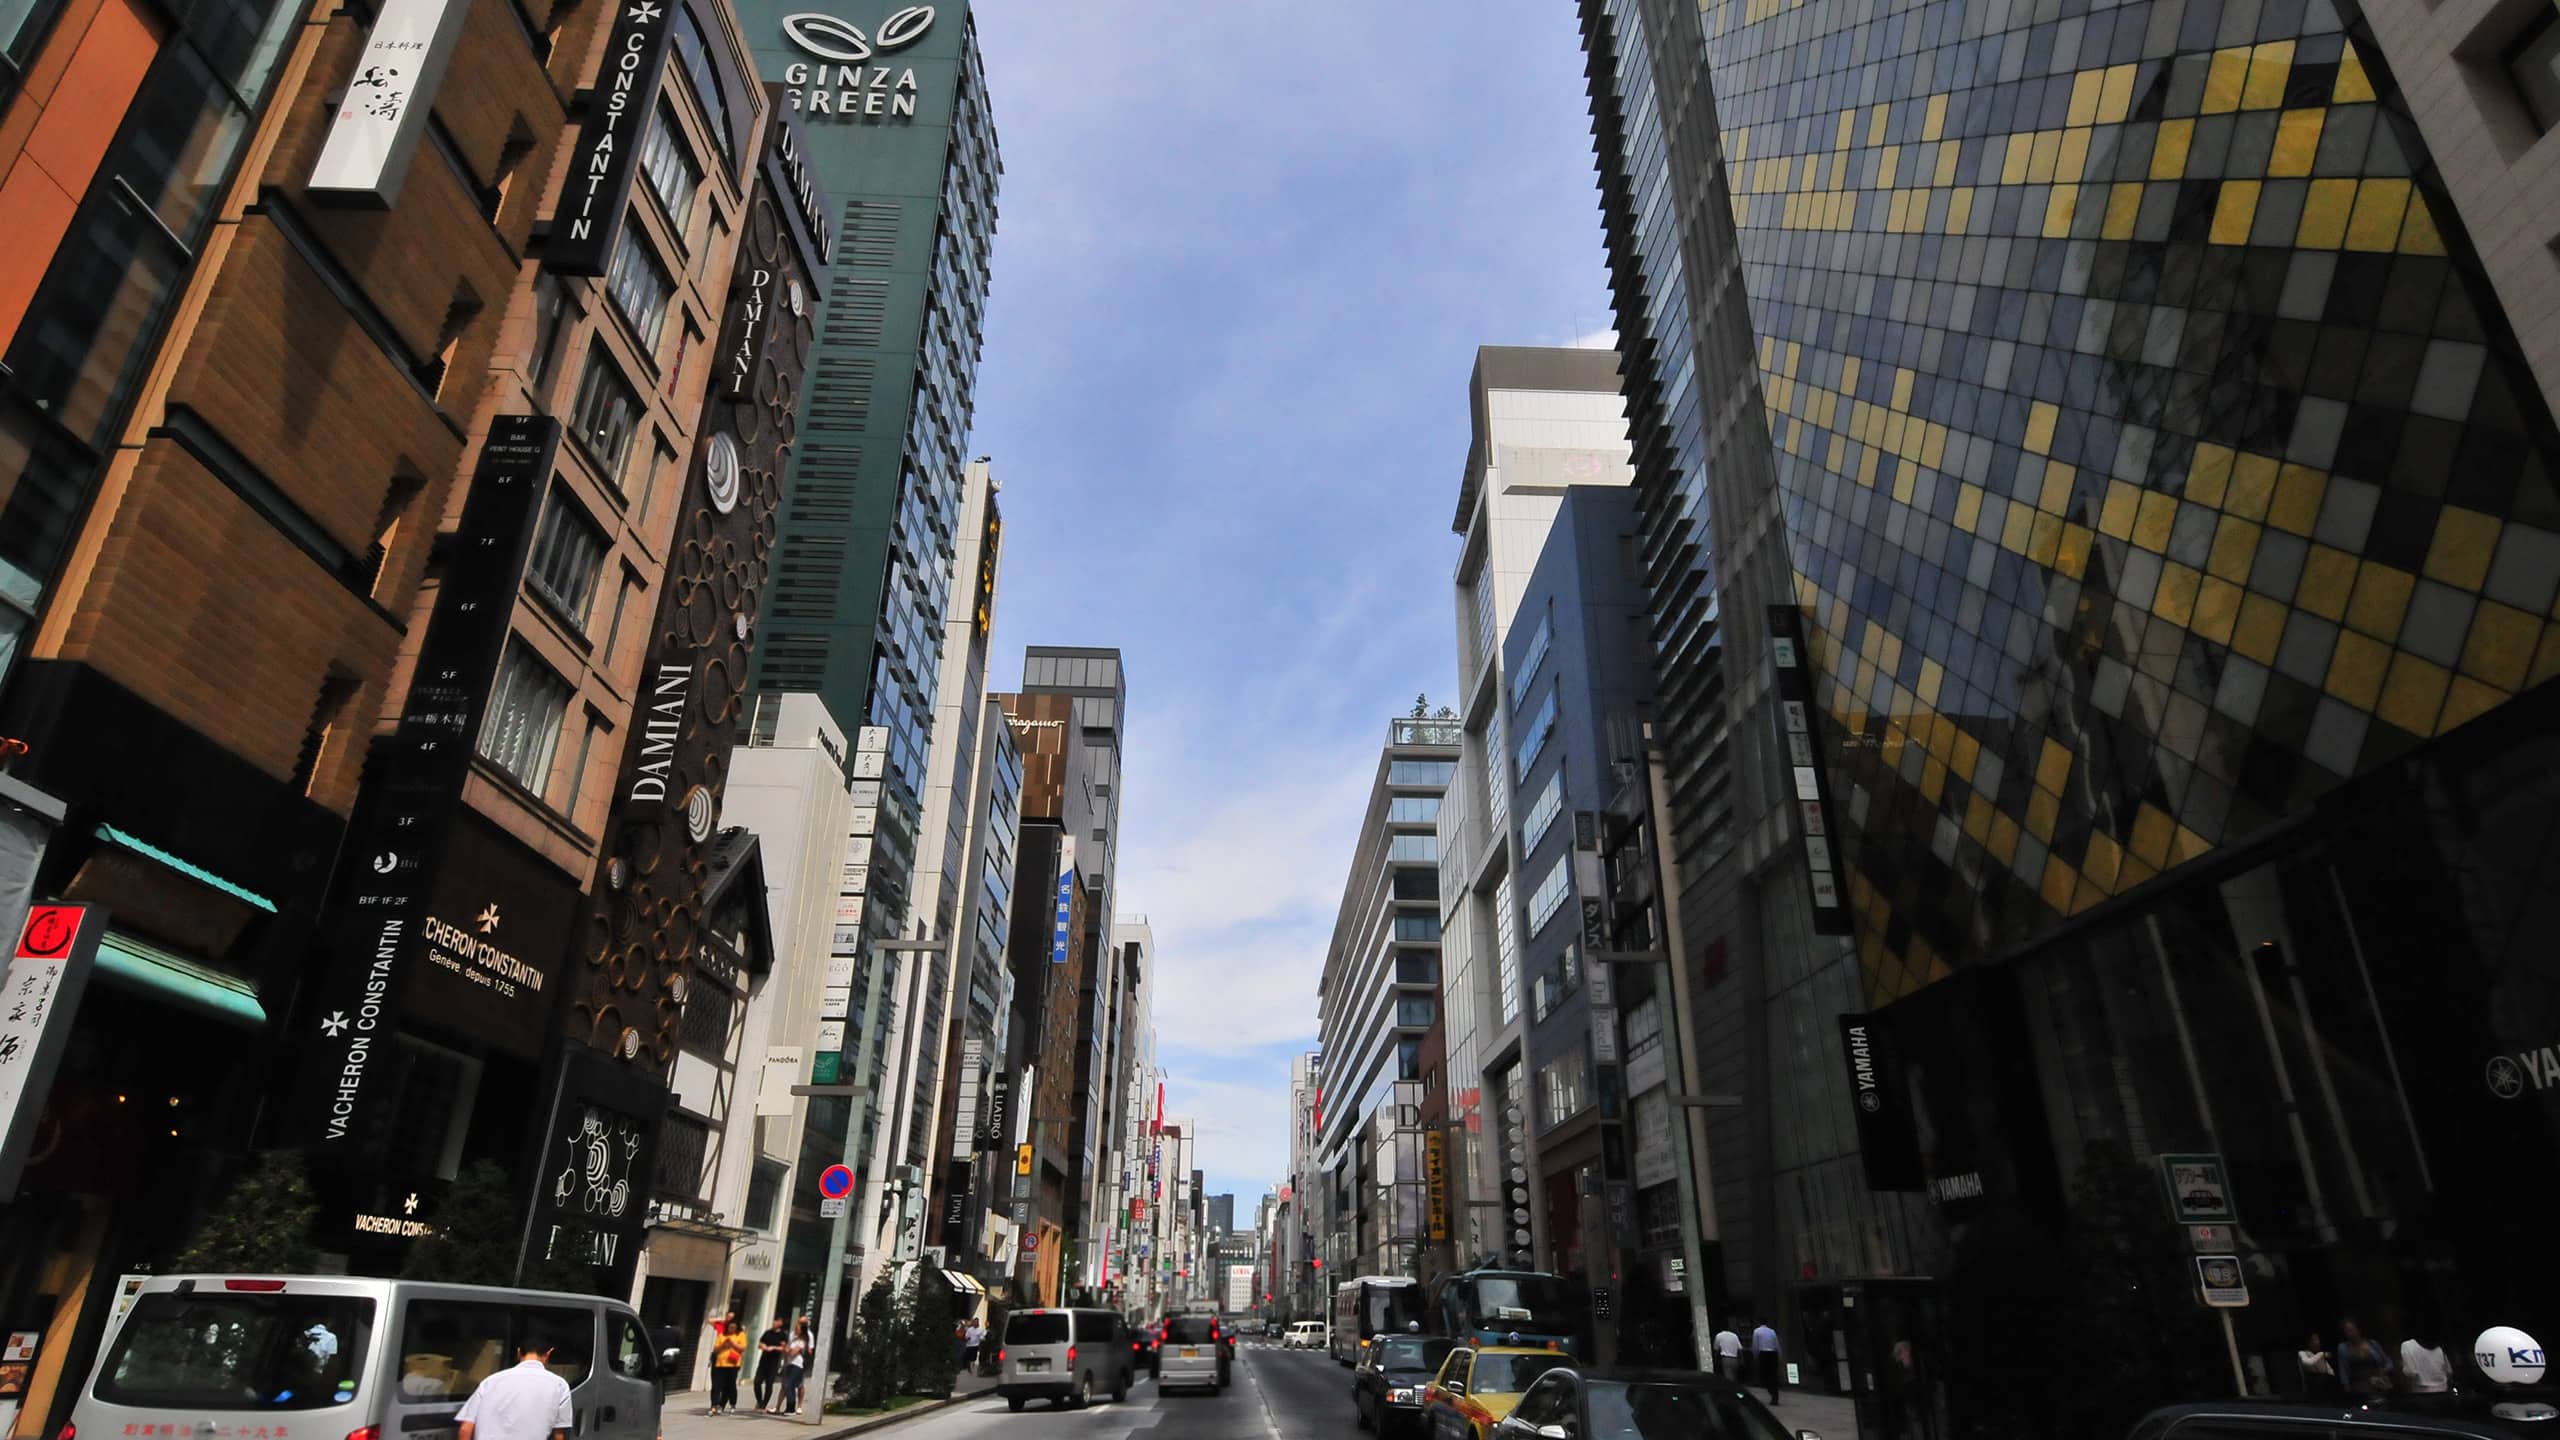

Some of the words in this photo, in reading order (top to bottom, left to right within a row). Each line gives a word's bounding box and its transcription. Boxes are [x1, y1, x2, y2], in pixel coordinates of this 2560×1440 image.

[785, 63, 918, 90] GINZA
[571, 33, 644, 240] CONSTANTIN
[732, 269, 770, 393] DAMIANI
[631, 664, 692, 803] DAMIANI
[424, 916, 476, 957] CHERON
[478, 944, 544, 992] CONSTANTIN
[465, 967, 491, 988] depuis
[495, 980, 515, 998] 1755
[325, 1037, 371, 1141] VACHERON
[358, 919, 404, 1031] CONSTANTIN
[1849, 1026, 1876, 1090] YAMAHA
[1938, 1171, 1983, 1200] YAMAHA
[355, 1213, 402, 1235] VACHERON
